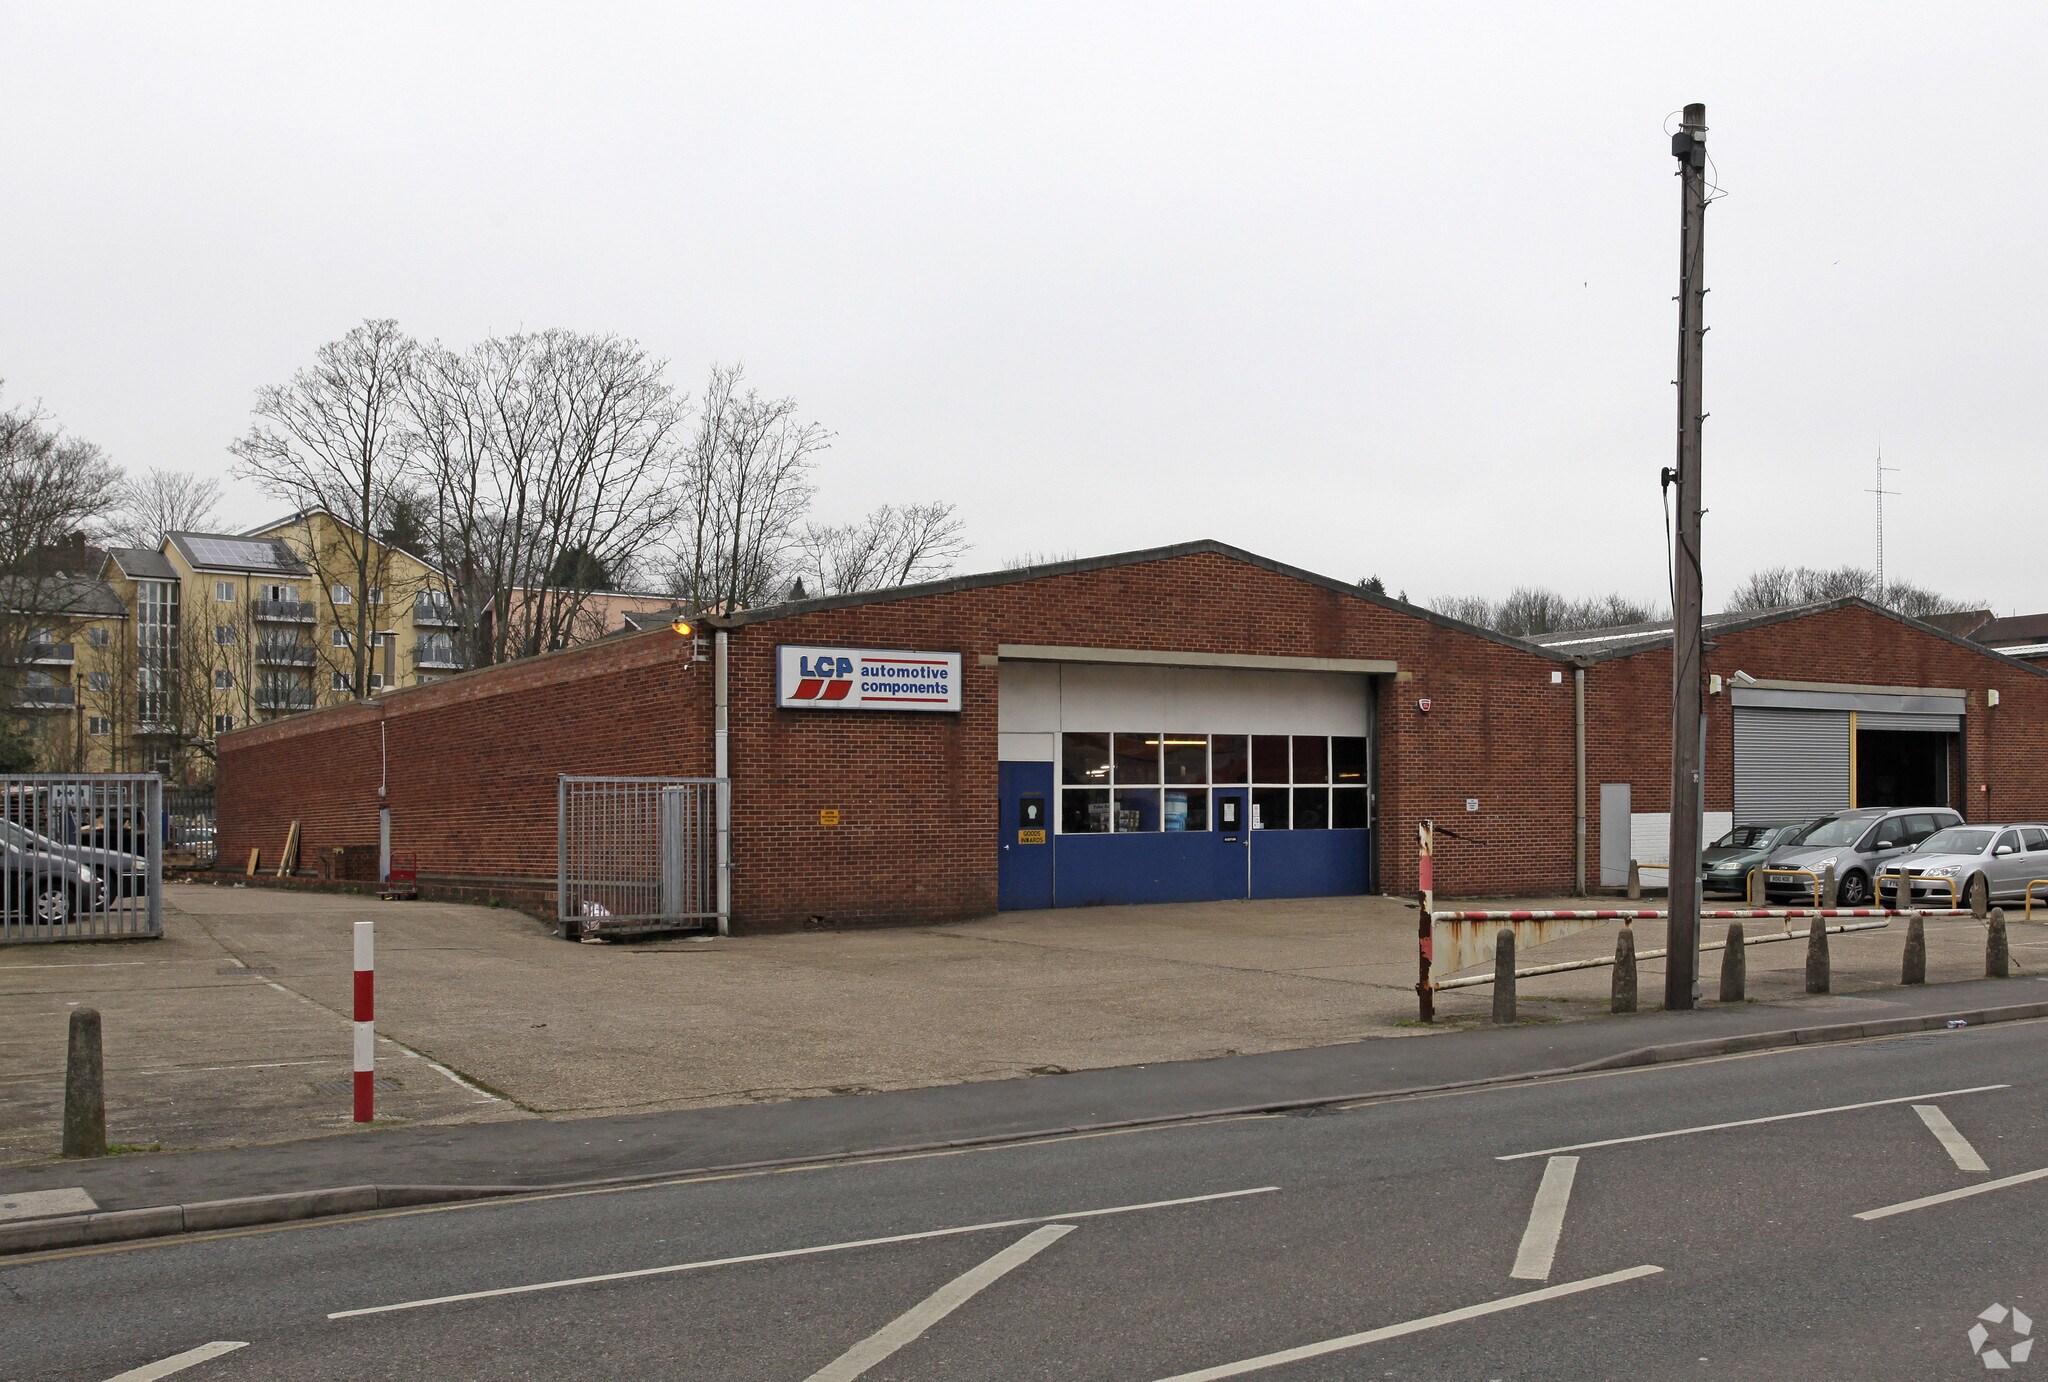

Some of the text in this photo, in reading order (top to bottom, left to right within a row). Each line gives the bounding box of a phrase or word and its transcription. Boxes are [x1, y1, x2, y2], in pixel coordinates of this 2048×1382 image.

[800, 656, 853, 678] LCP
[861, 665, 948, 679] automotive
[861, 682, 948, 695] components
